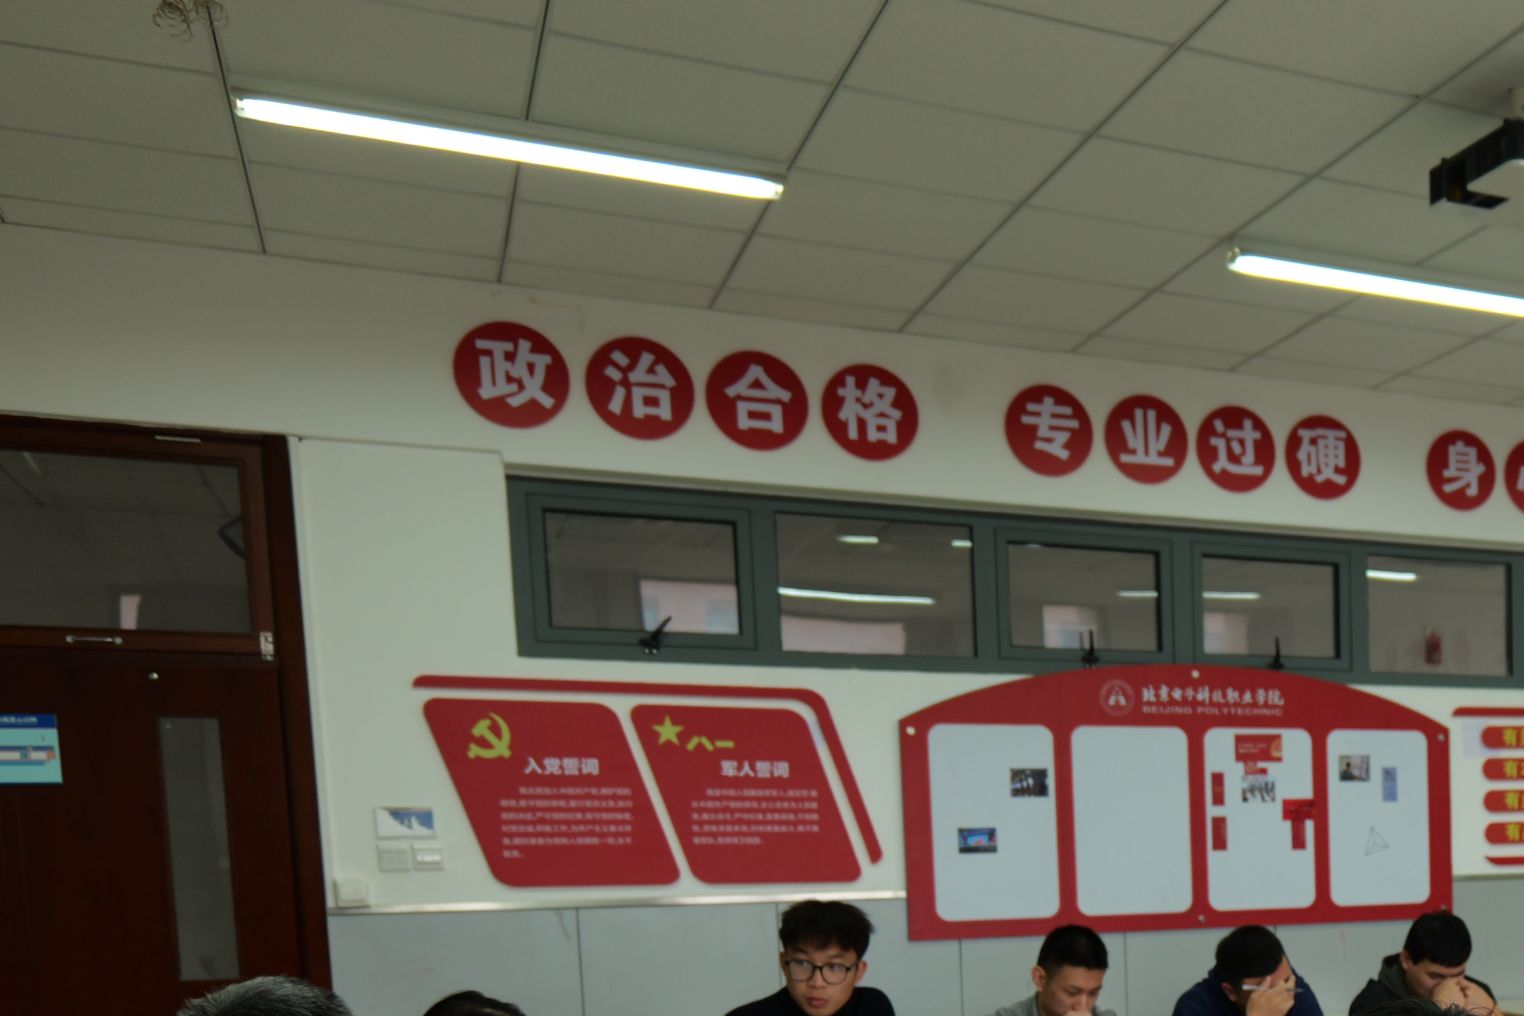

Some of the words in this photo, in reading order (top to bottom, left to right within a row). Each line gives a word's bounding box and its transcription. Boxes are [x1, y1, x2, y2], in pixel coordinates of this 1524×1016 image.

[474, 336, 902, 446] 政治合格
[1018, 396, 1349, 488] 专业过硬
[1142, 705, 1192, 715] BEIJING
[1197, 706, 1283, 717] POLYTECHNIC
[524, 756, 600, 776] 入党誓词
[720, 759, 790, 779] 军人誓词
